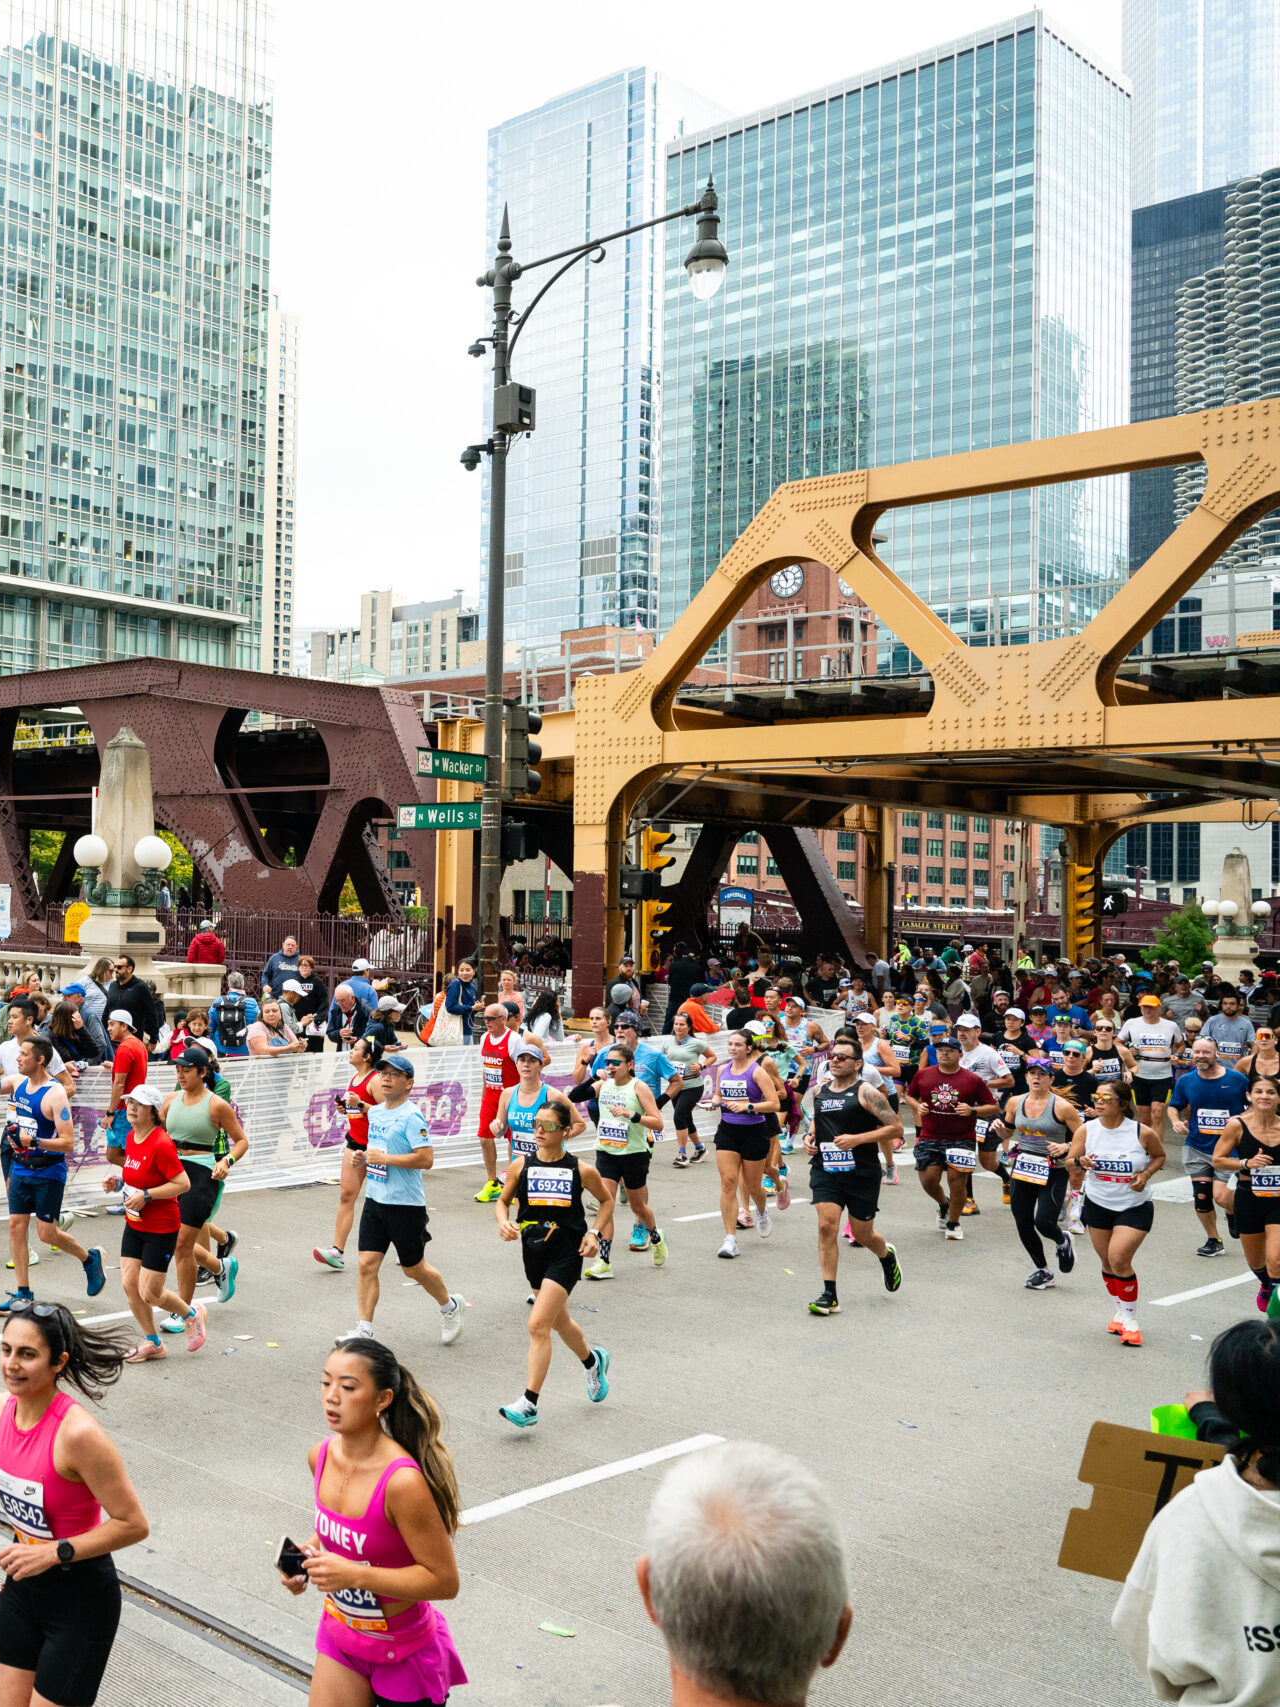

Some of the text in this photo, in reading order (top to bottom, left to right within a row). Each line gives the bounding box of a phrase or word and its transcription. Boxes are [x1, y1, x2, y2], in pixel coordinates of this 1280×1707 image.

[442, 757, 474, 775] Wacker
[476, 764, 483, 773] Dr
[418, 809, 478, 823] N Wells St
[725, 1088, 748, 1097] 70552
[1198, 1117, 1203, 1125] K
[514, 1143, 540, 1153] K 6323
[822, 1151, 854, 1161] G 38978
[1015, 1160, 1050, 1176] K 52356
[1098, 1161, 1132, 1172] 32381
[1252, 1175, 1259, 1185] K
[527, 1179, 571, 1193] K 69243
[2, 1493, 48, 1528] 58542
